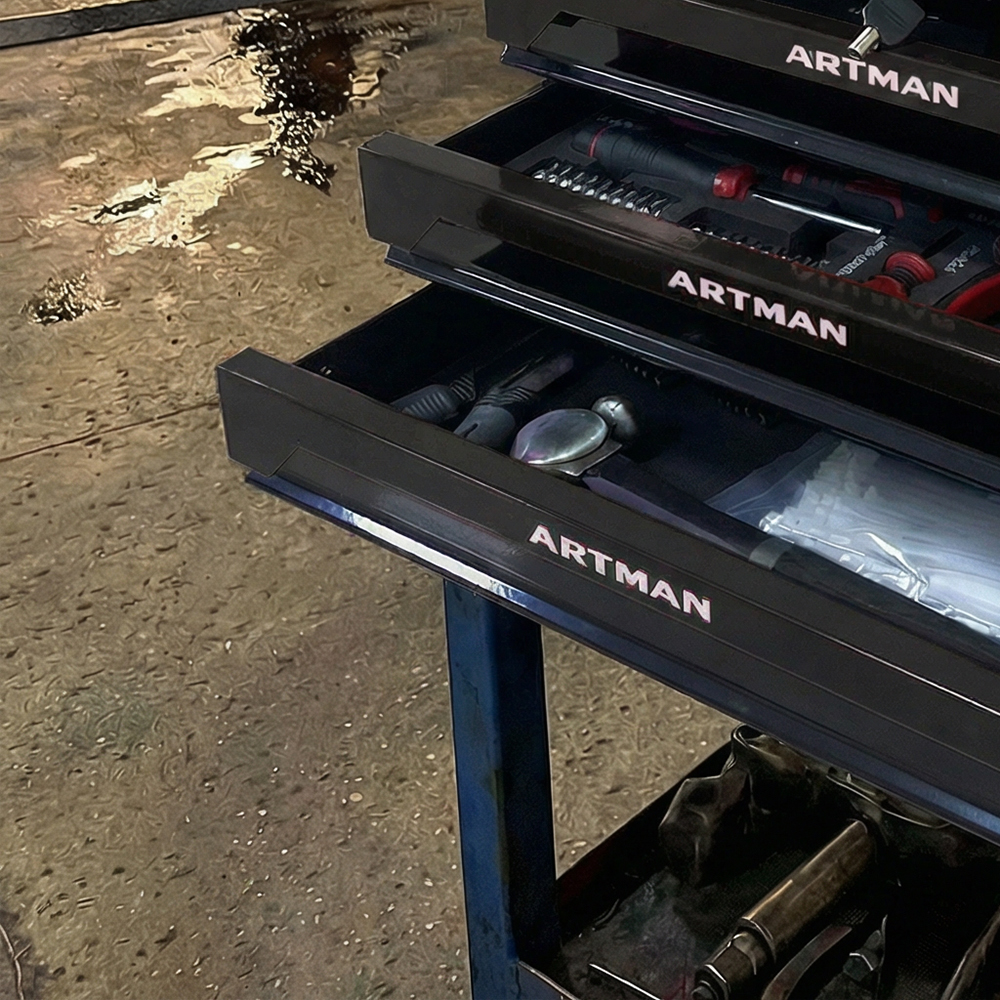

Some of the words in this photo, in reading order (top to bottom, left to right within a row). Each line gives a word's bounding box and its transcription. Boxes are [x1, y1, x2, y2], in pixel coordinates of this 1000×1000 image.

[785, 44, 959, 109] ARTMAN
[667, 269, 847, 347] ARTMAN
[528, 524, 711, 624] ARTMAN
